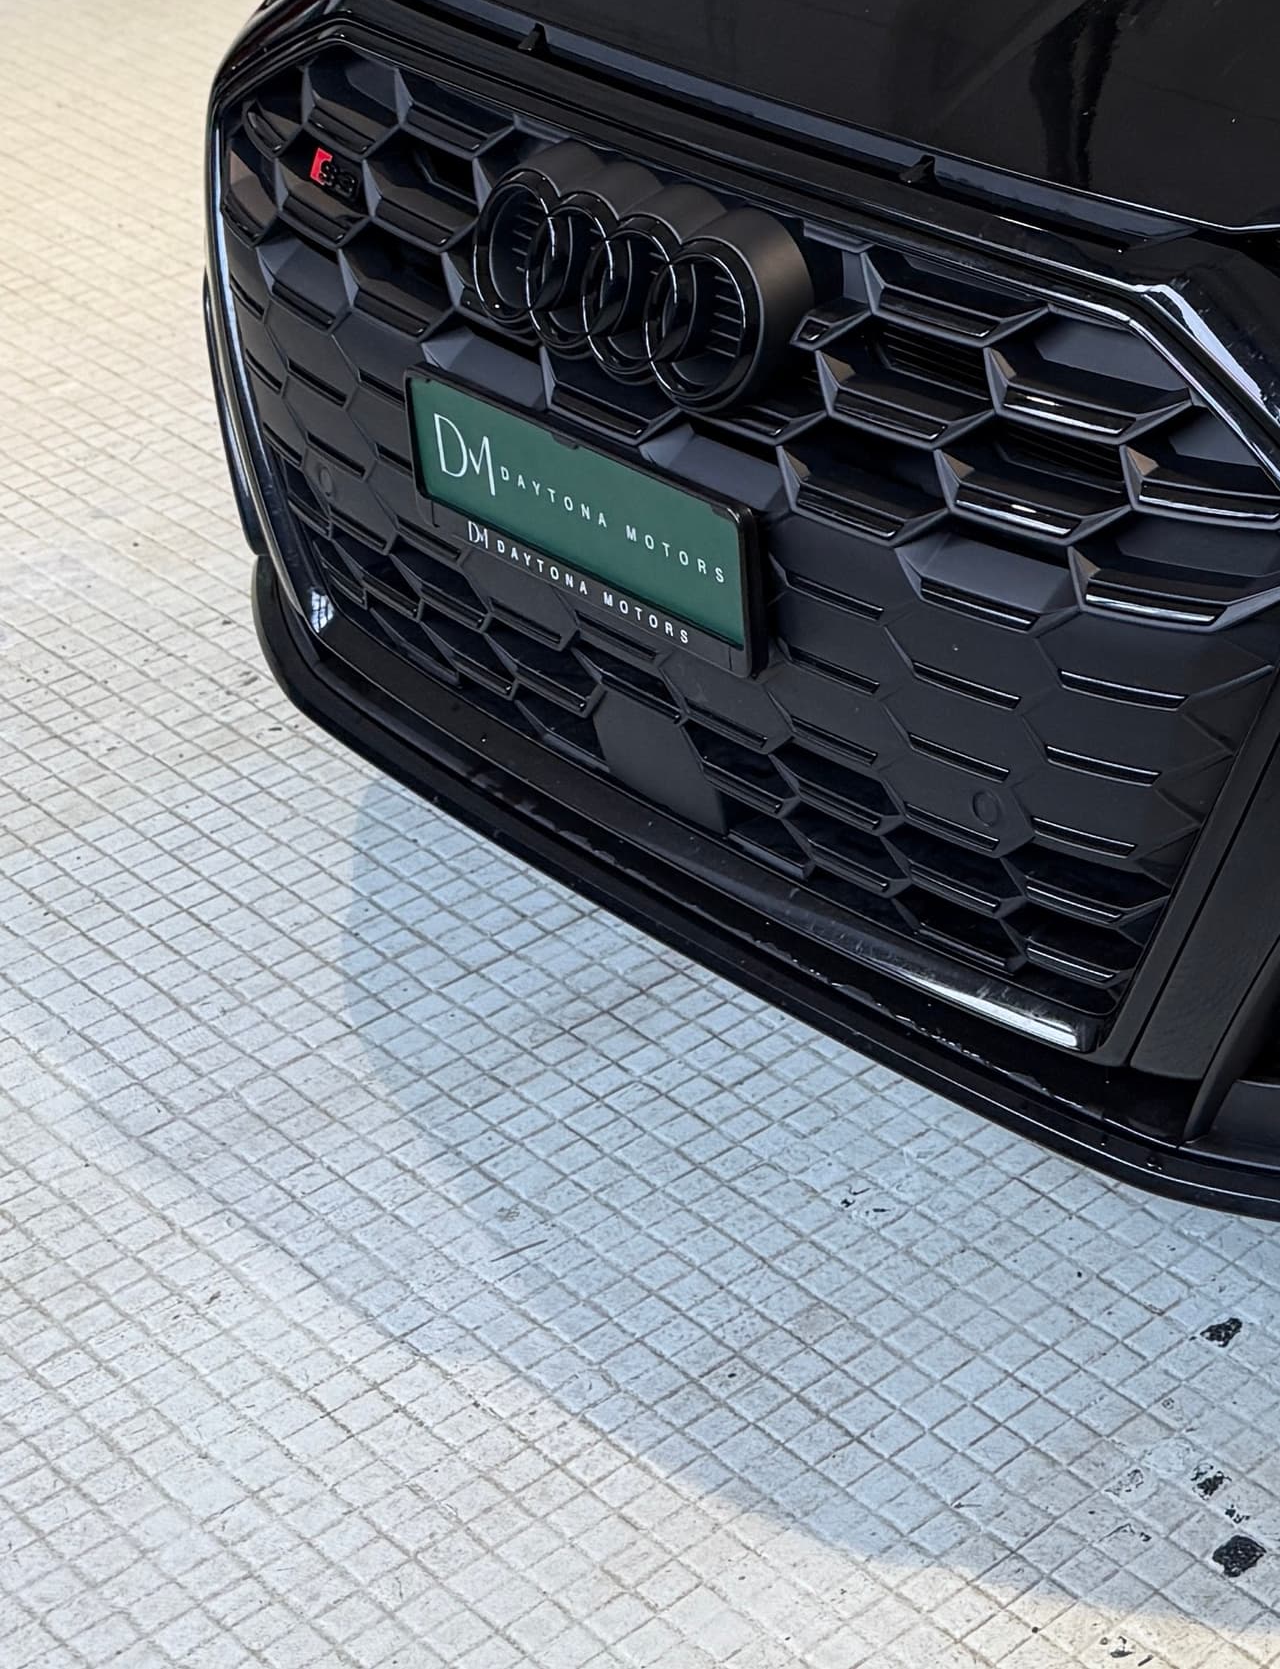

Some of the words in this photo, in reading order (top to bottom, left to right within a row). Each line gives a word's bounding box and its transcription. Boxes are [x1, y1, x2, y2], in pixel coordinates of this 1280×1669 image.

[500, 466, 607, 528] DAYTONA
[626, 525, 725, 583] MOTORS
[497, 540, 588, 595] DAYTONA
[603, 592, 689, 644] MOTORS
